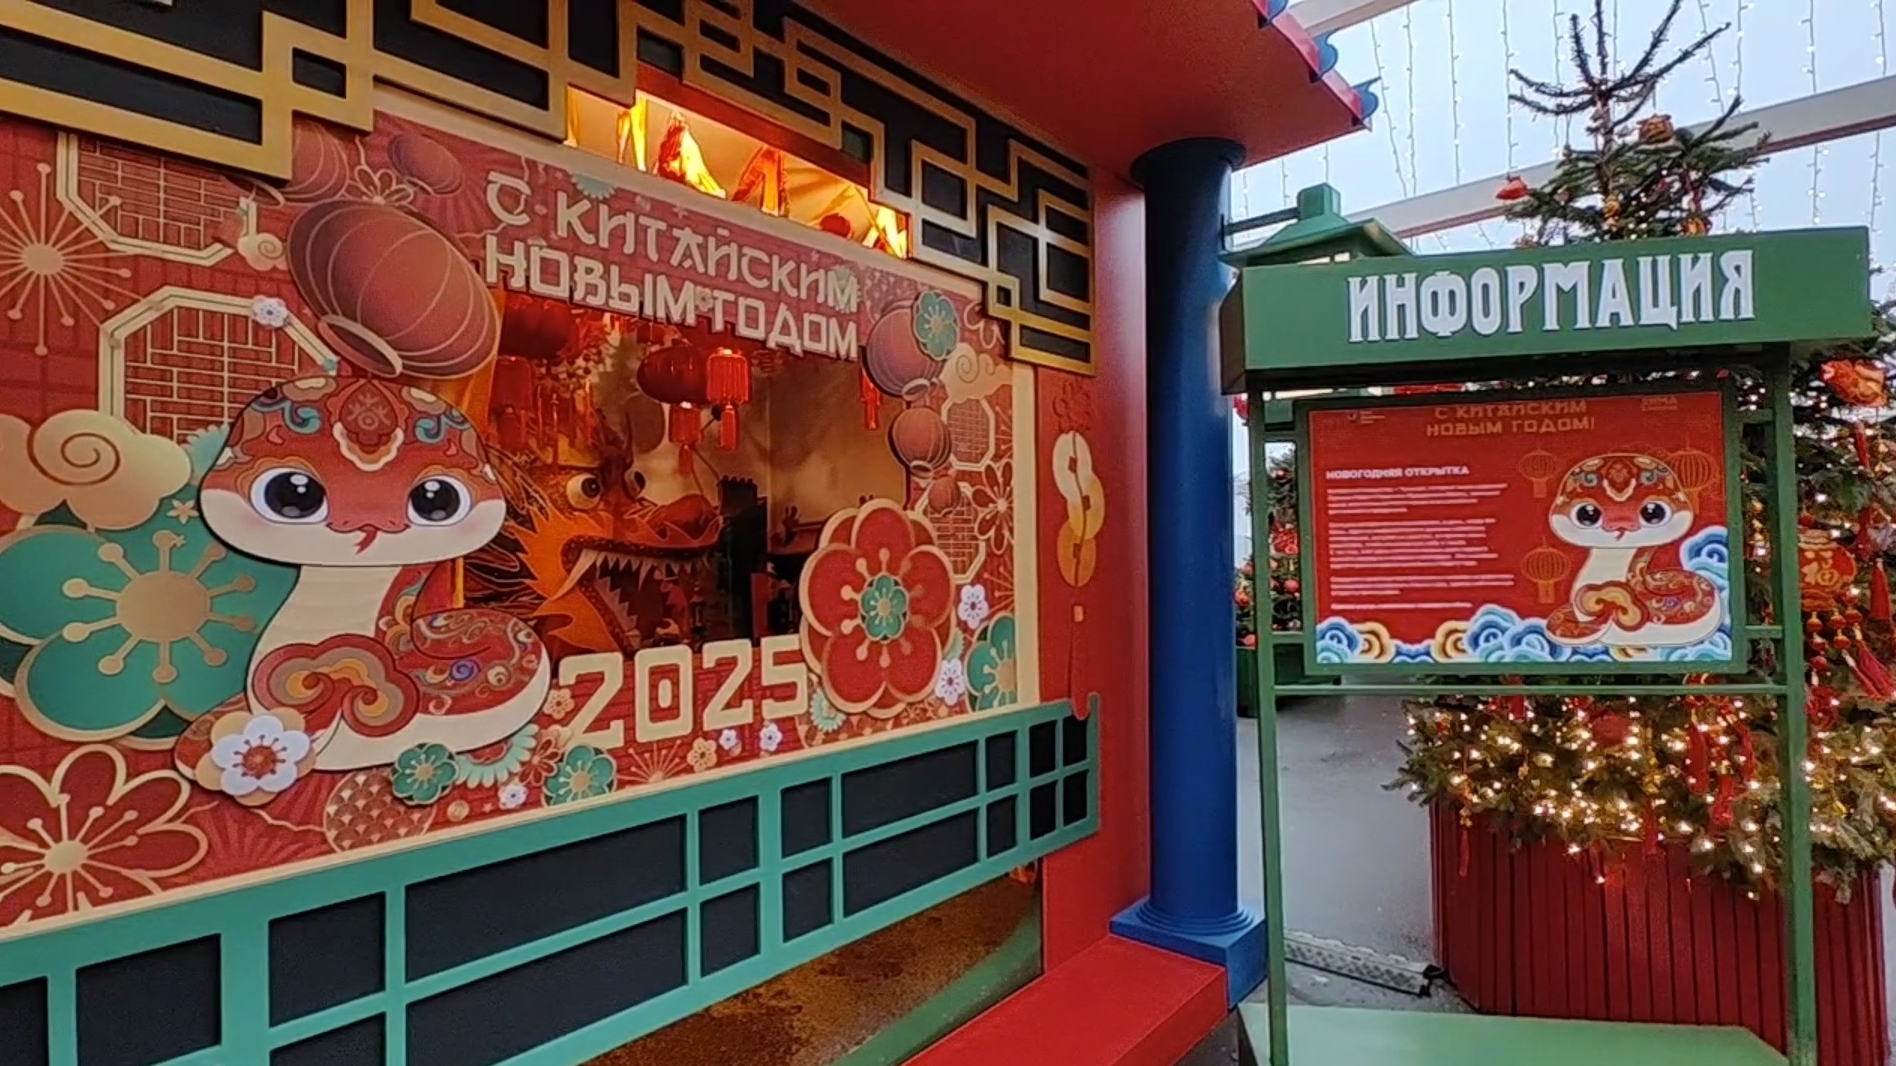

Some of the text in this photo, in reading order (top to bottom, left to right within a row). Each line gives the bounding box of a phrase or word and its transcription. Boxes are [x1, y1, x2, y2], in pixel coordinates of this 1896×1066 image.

[486, 170, 859, 313] С КИТАЙСКИМ
[484, 234, 860, 361] НОВЫМ ГОДОМ
[1346, 248, 1757, 344] ИНФОРМАЦИЯ
[1426, 416, 1596, 437] НОВЫМ ГОДОМ!
[1434, 407, 1448, 419] С
[558, 633, 809, 751] 2025
